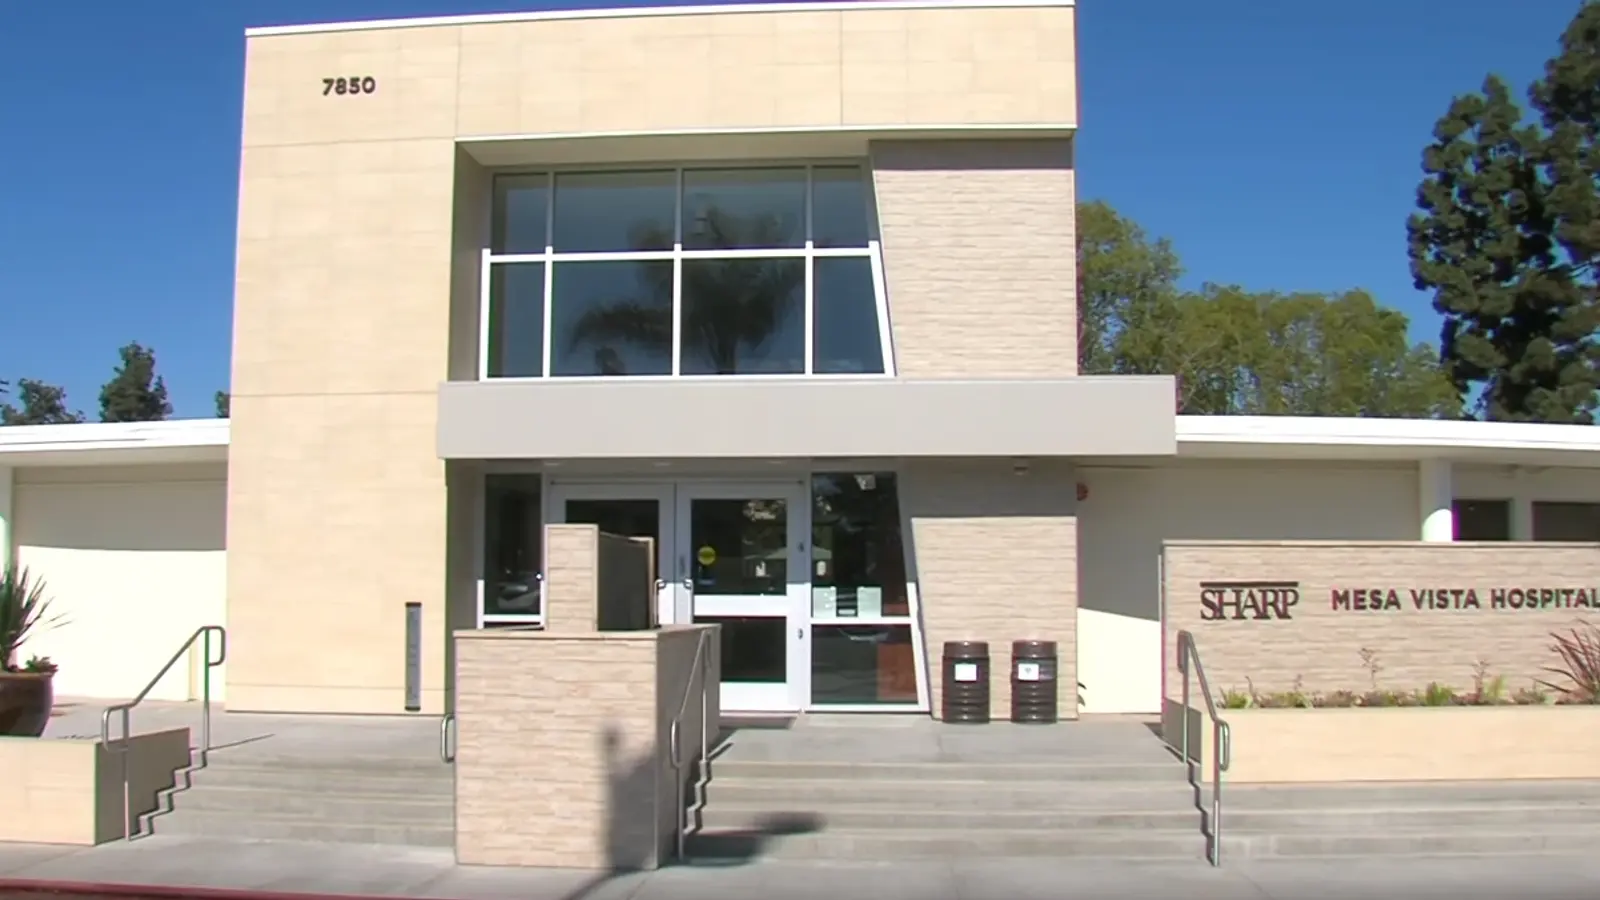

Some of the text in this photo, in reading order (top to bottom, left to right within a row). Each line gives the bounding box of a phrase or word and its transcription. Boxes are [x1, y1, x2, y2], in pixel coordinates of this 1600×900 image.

[322, 76, 376, 96] 7850
[1200, 586, 1600, 620] SHARP MESA VISTA HOSPITAL
